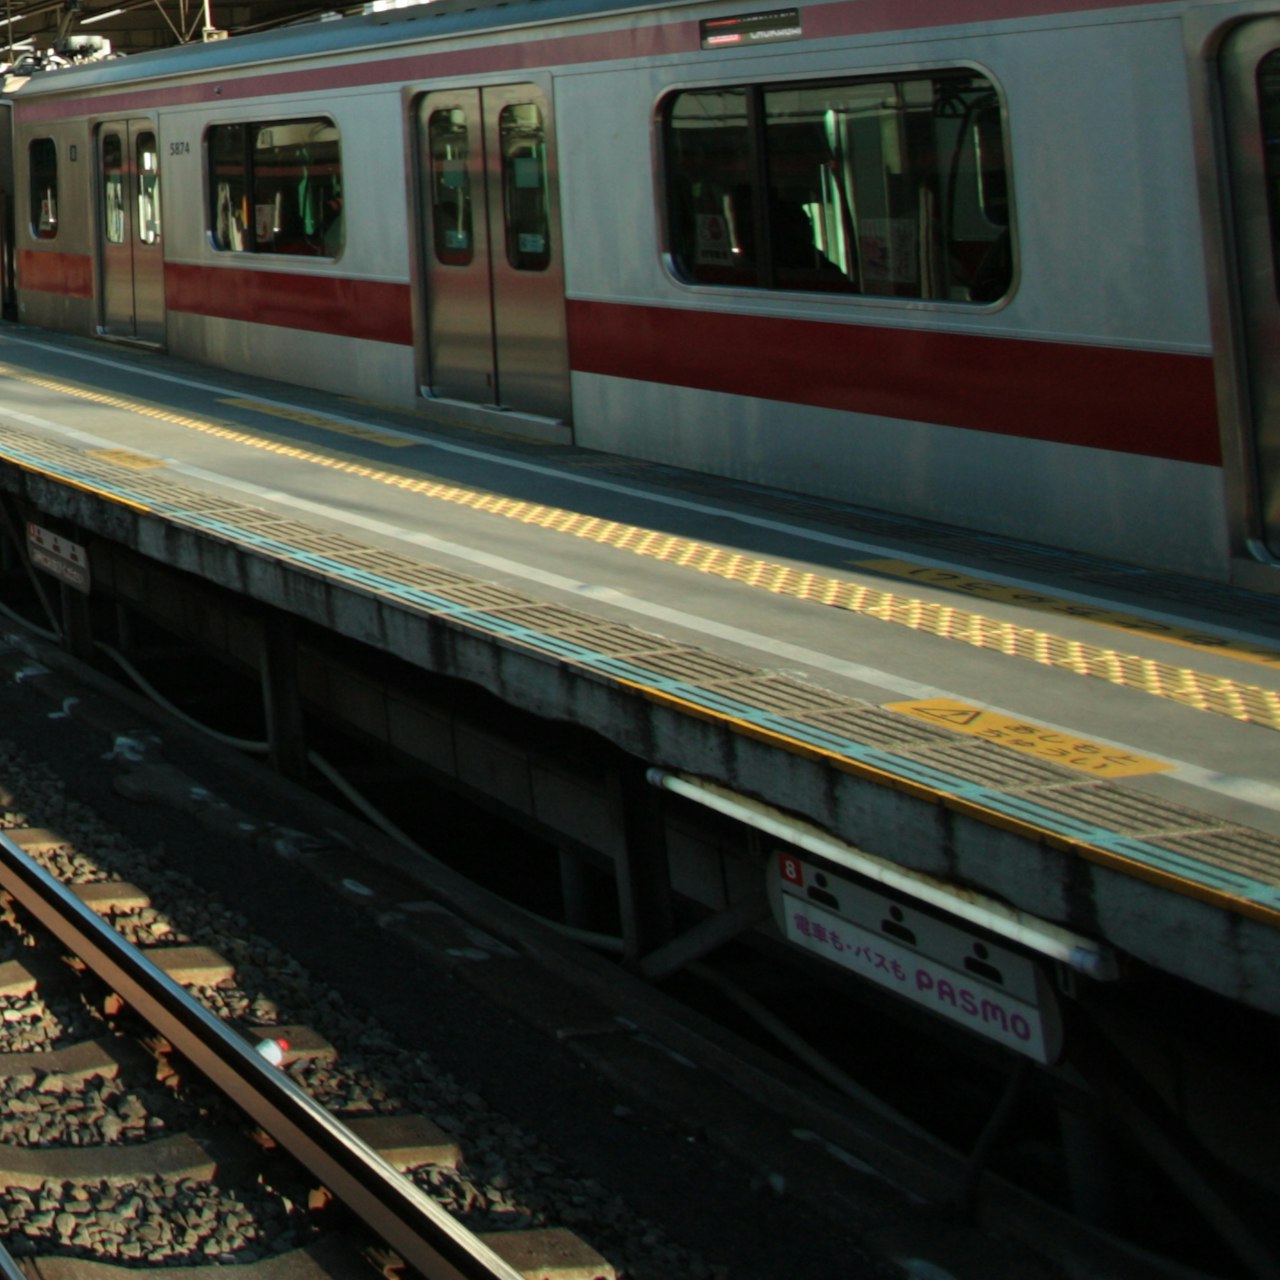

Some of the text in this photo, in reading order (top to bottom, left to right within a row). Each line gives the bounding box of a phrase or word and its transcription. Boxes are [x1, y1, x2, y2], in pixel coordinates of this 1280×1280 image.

[785, 861, 797, 880] 8
[793, 912, 1031, 1041] 電車も・バスも PASMO
